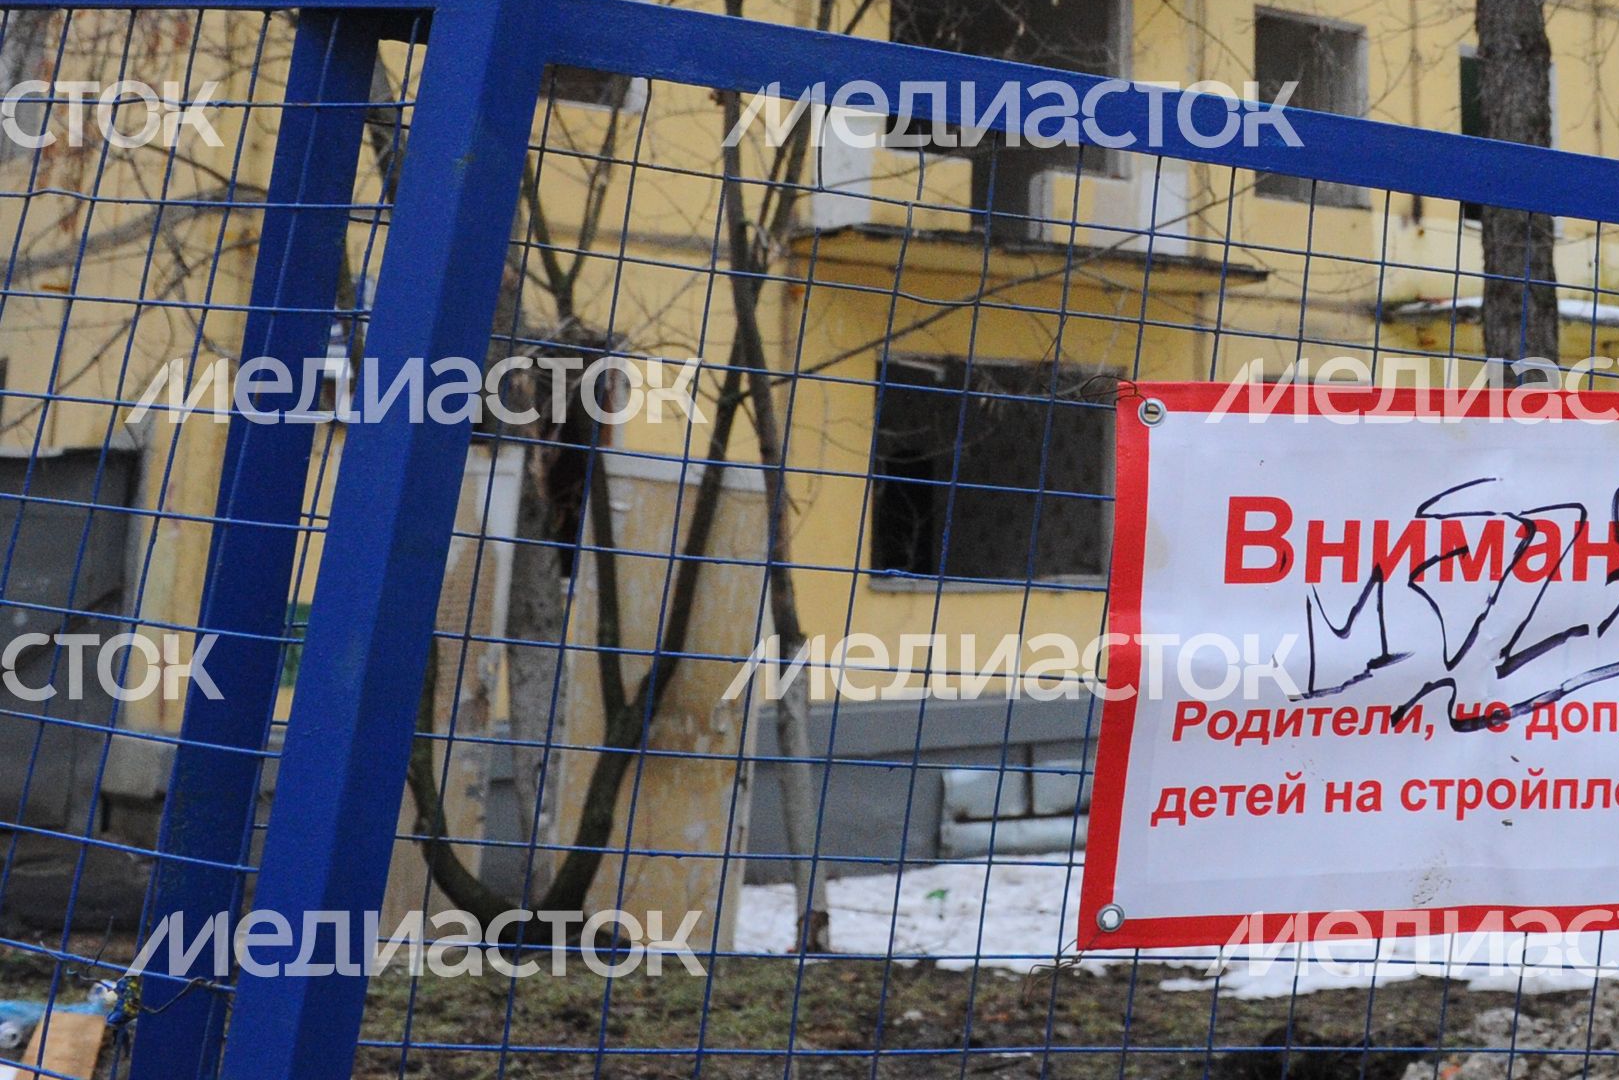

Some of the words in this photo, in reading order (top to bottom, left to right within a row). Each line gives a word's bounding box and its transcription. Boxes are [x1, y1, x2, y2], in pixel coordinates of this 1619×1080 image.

[1172, 700, 1435, 746] Родители,
[1455, 701, 1511, 733] не
[1151, 772, 1306, 827] детей
[1324, 779, 1383, 813] на
